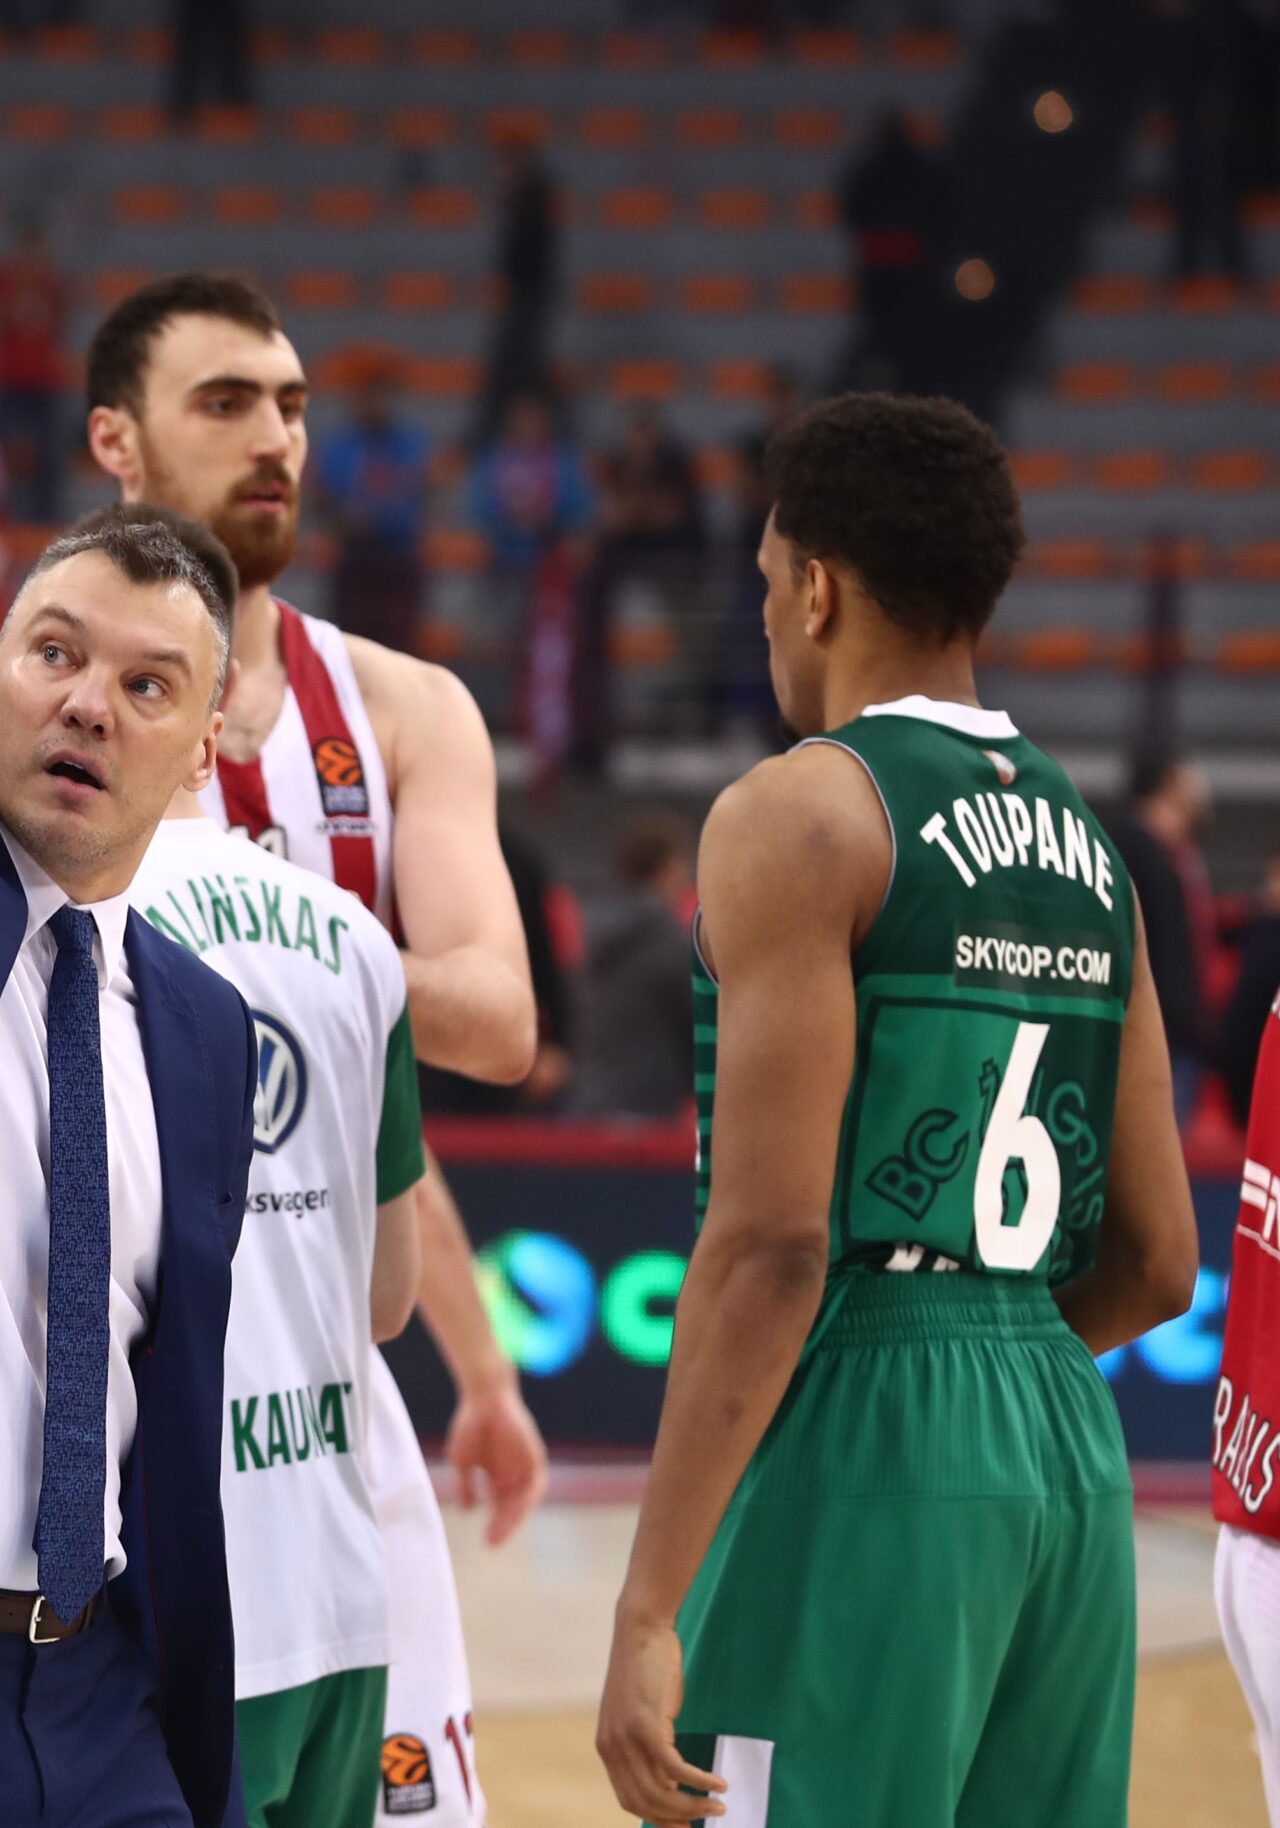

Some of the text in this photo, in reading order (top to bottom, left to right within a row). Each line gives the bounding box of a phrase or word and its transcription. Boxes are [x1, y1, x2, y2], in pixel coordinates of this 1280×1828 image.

[920, 792, 1114, 911] TOUPANE
[956, 935, 1111, 985] SKYCOP.COM
[865, 1107, 970, 1223] BC
[974, 1021, 1061, 1271] 6
[231, 1381, 352, 1472] KAUNA
